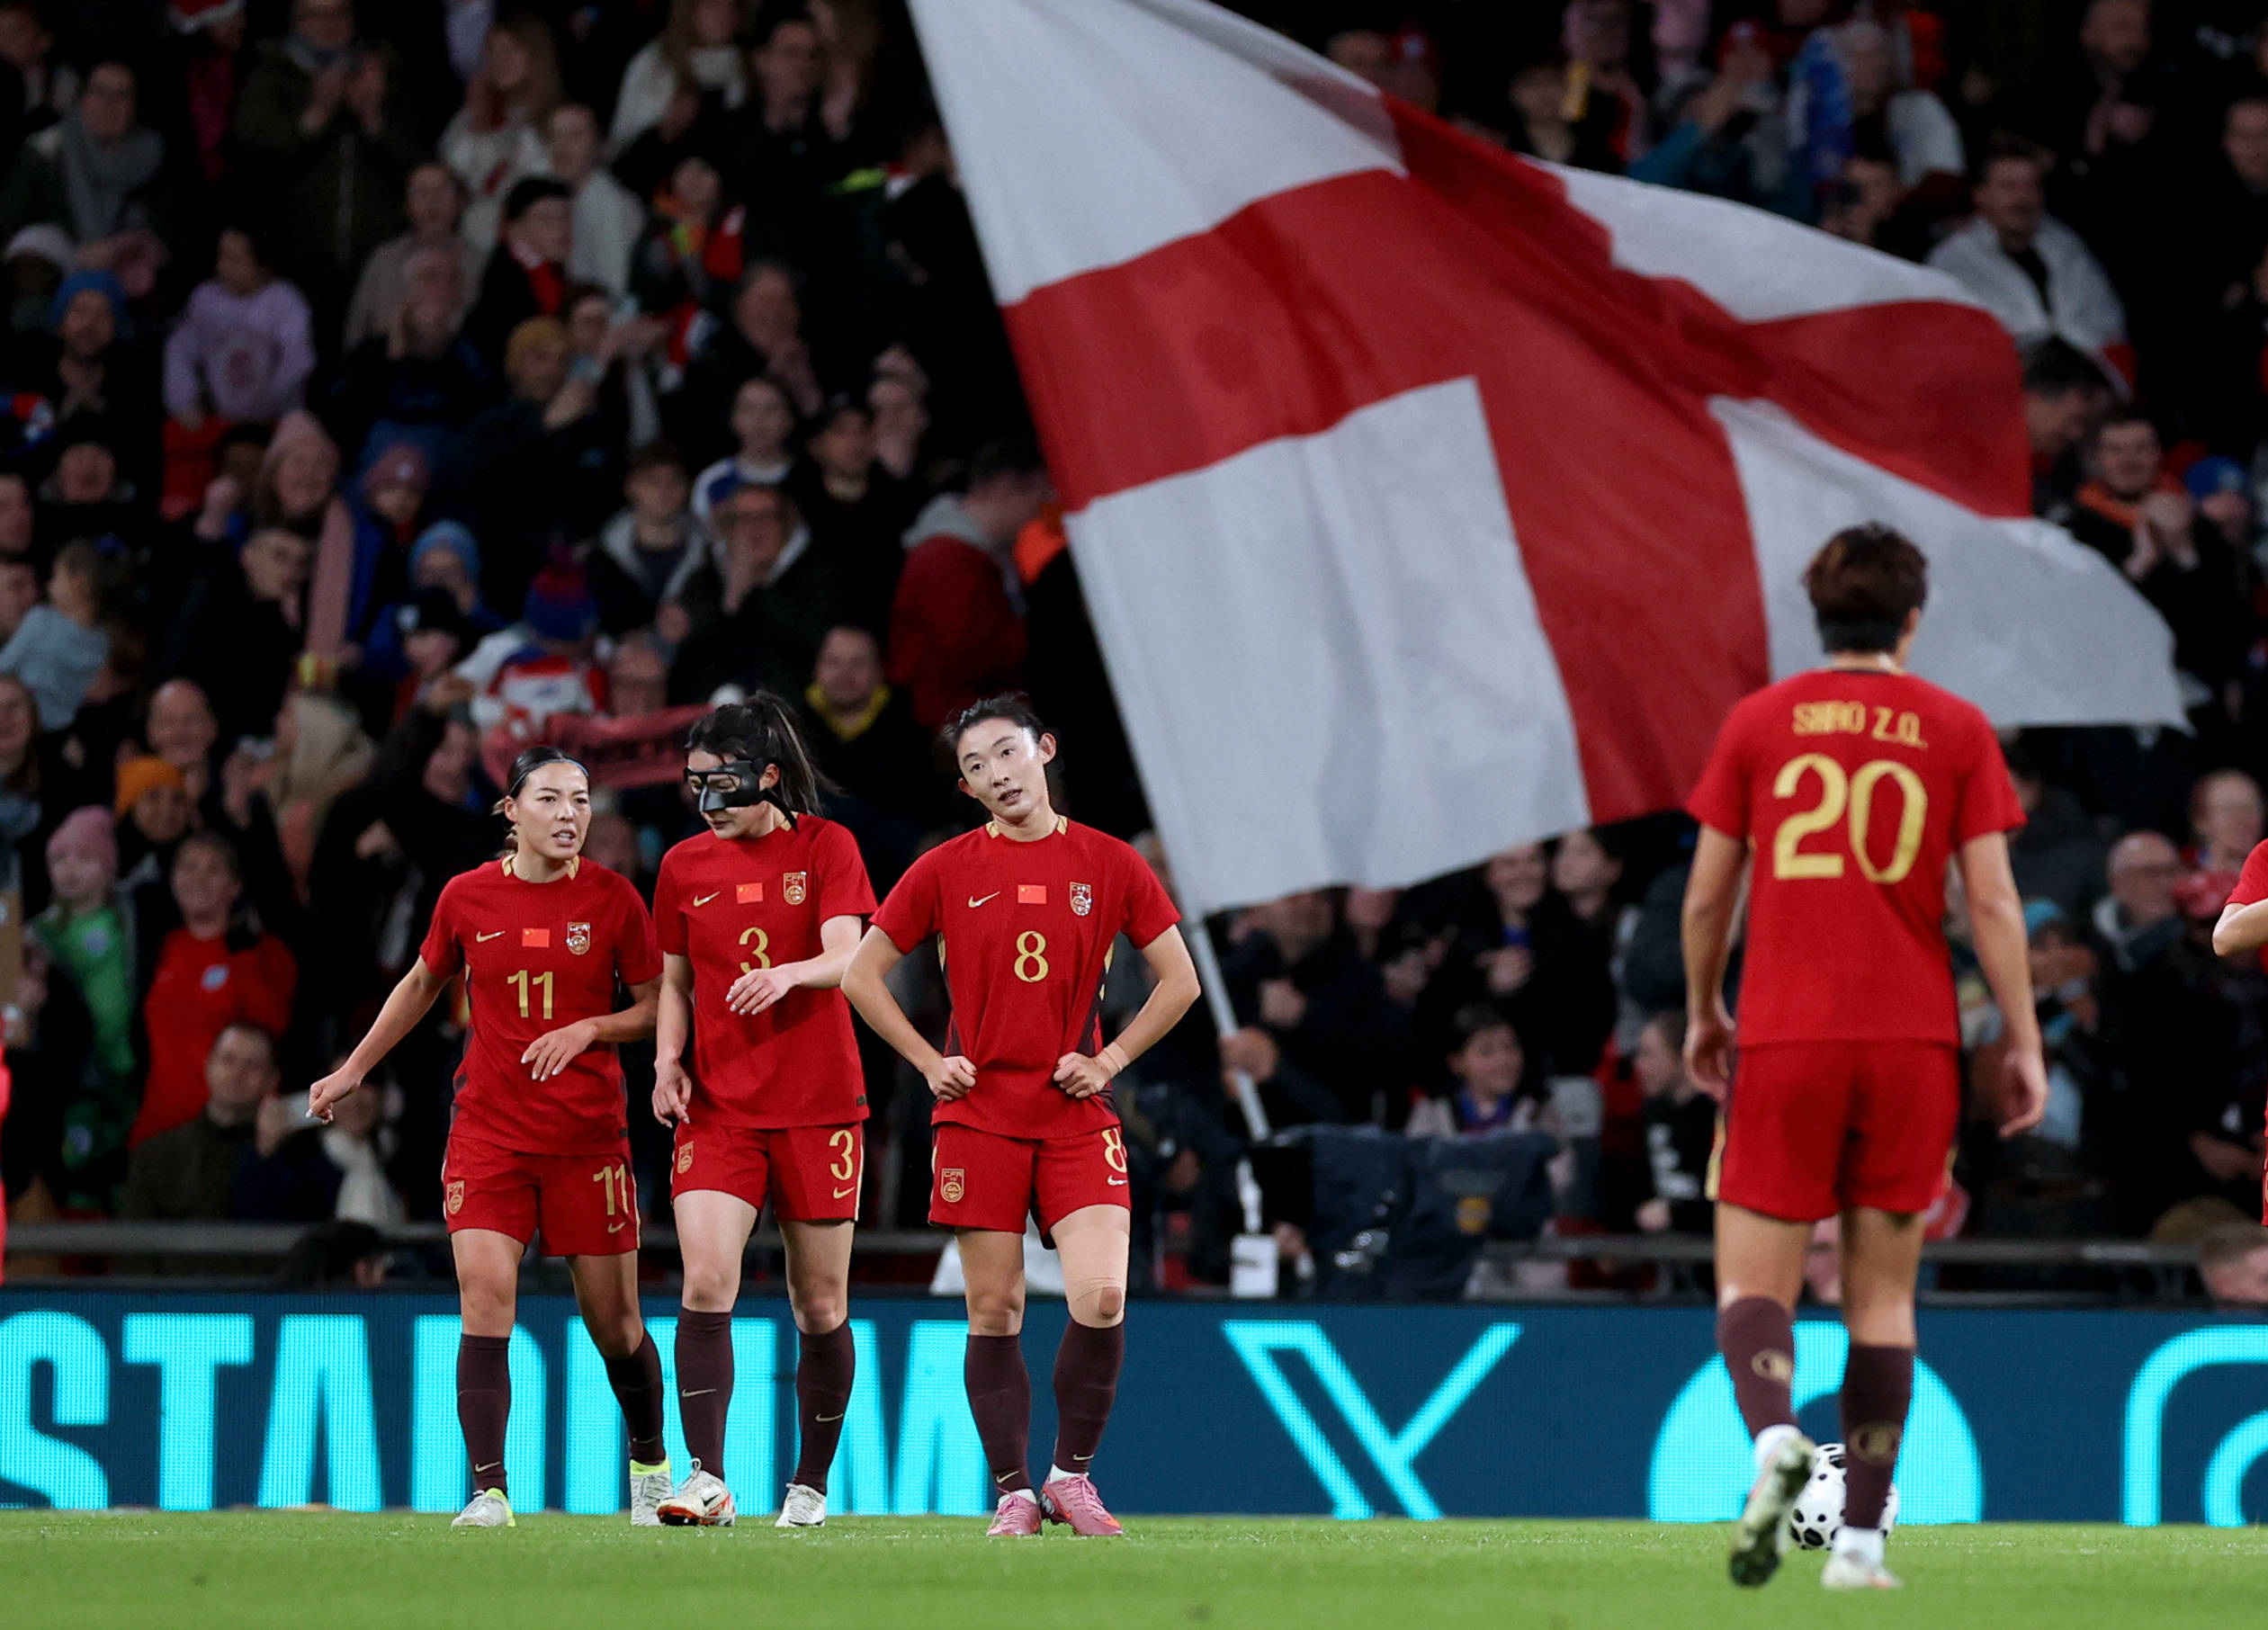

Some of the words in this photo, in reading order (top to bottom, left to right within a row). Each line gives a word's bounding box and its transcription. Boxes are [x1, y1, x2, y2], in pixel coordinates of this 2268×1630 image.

[1772, 752, 1928, 885] 20
[739, 927, 771, 974] 3
[1014, 930, 1049, 983] 8
[506, 970, 554, 1020] 11
[829, 1130, 855, 1181] 3
[1101, 1128, 1128, 1173] 8
[593, 1163, 629, 1215] 11
